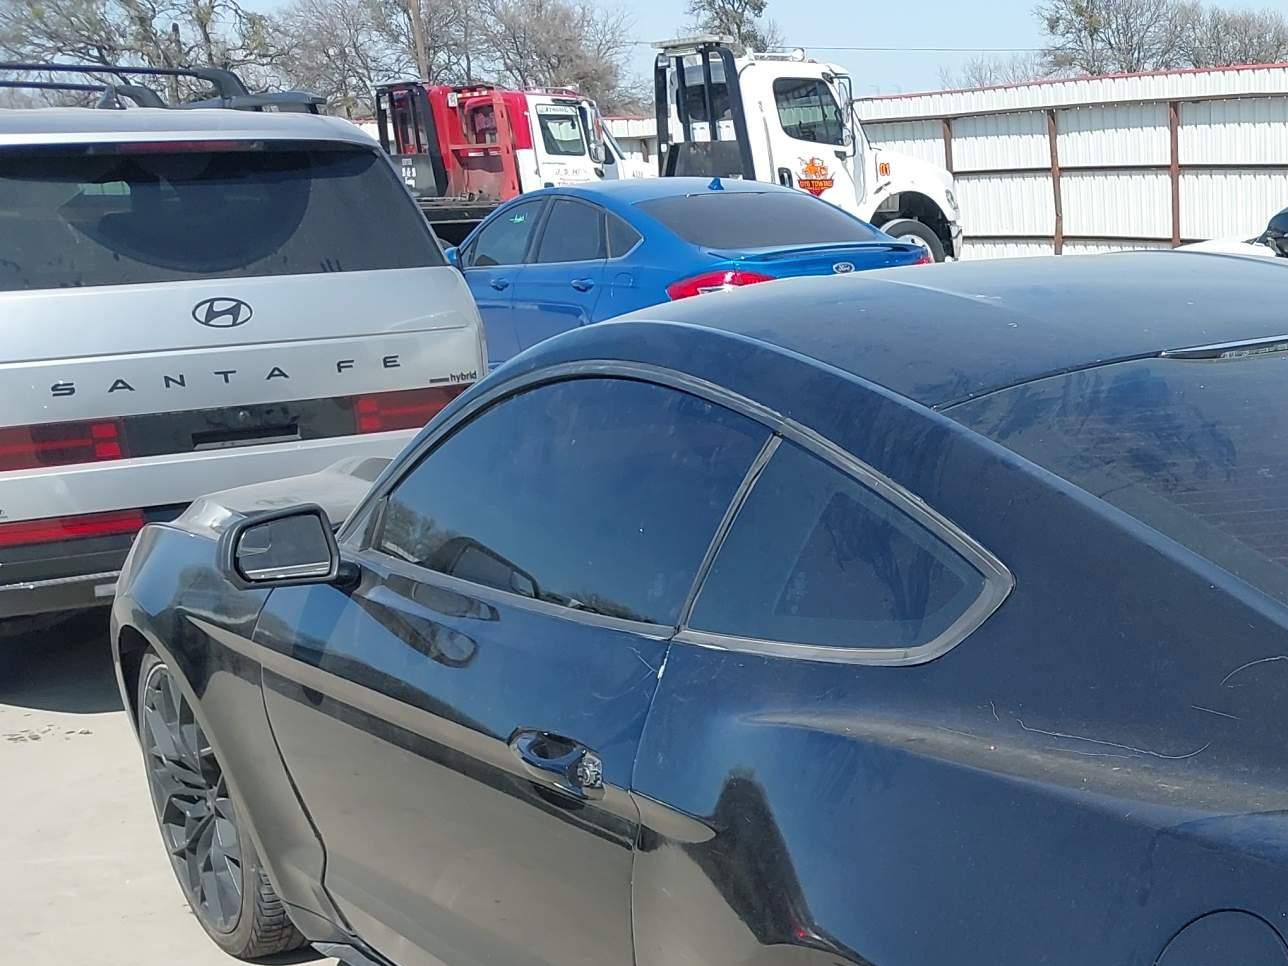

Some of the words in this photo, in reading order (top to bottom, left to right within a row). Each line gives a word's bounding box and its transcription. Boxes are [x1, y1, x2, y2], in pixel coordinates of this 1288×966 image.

[51, 366, 290, 397] SANTA
[336, 355, 400, 373] FE
[449, 370, 477, 383] hybrid
